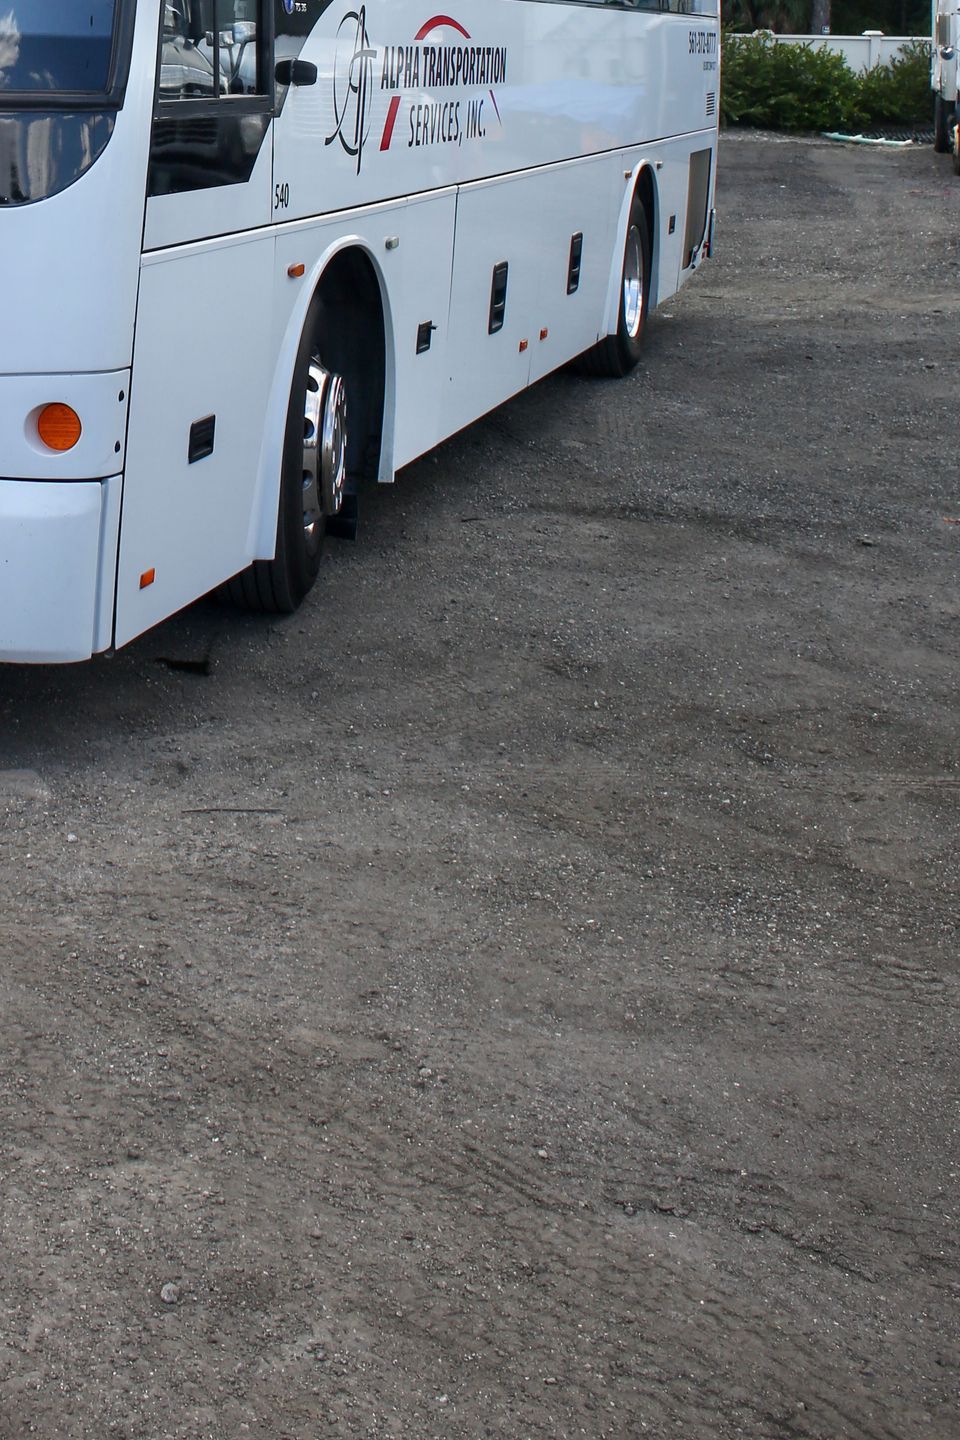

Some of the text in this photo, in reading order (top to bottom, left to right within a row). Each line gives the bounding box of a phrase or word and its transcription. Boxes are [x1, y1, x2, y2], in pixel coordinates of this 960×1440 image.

[380, 45, 507, 90] ALPHA TRANSPORTATION
[408, 99, 486, 147] SERVICES, INC.
[274, 183, 290, 210] 540
